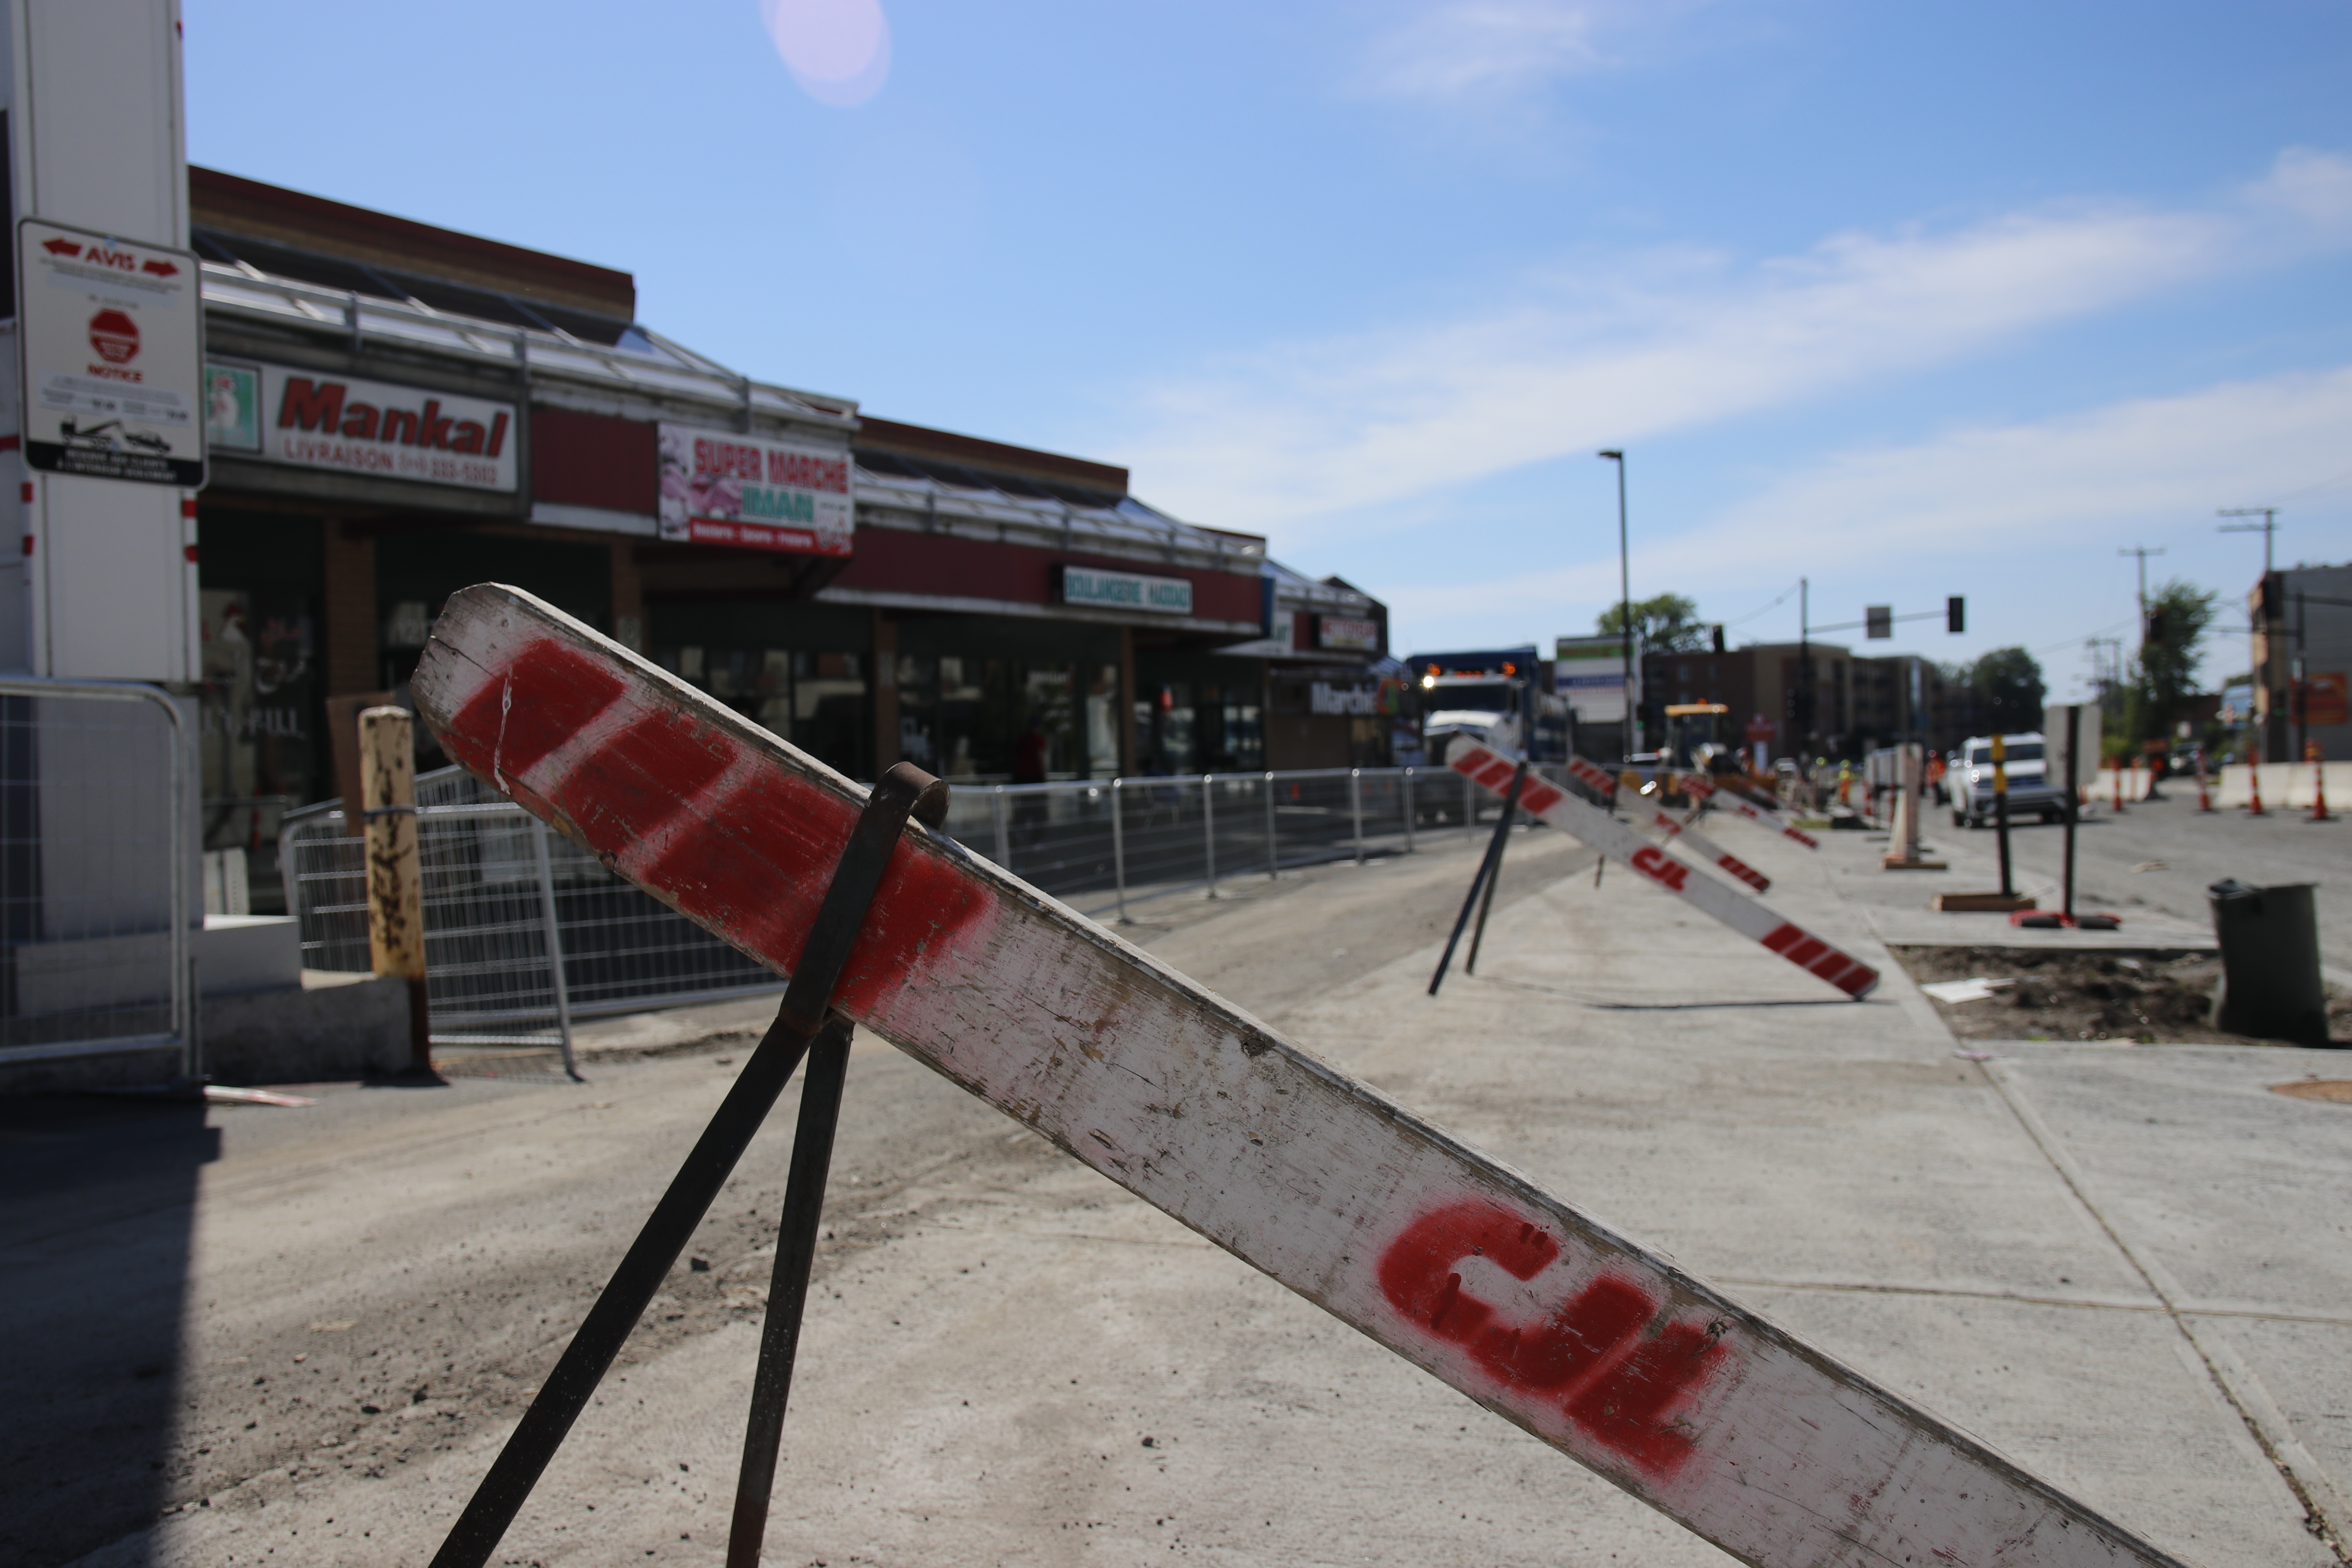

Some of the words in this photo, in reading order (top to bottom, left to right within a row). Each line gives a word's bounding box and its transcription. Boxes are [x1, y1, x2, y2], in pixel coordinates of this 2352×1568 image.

[85, 246, 136, 271] AVIS
[88, 365, 142, 383] NOTICE
[279, 376, 510, 459] Mankal
[284, 438, 394, 471] LIVRAISON
[694, 437, 762, 481] SUPER
[742, 487, 814, 522] IMAN
